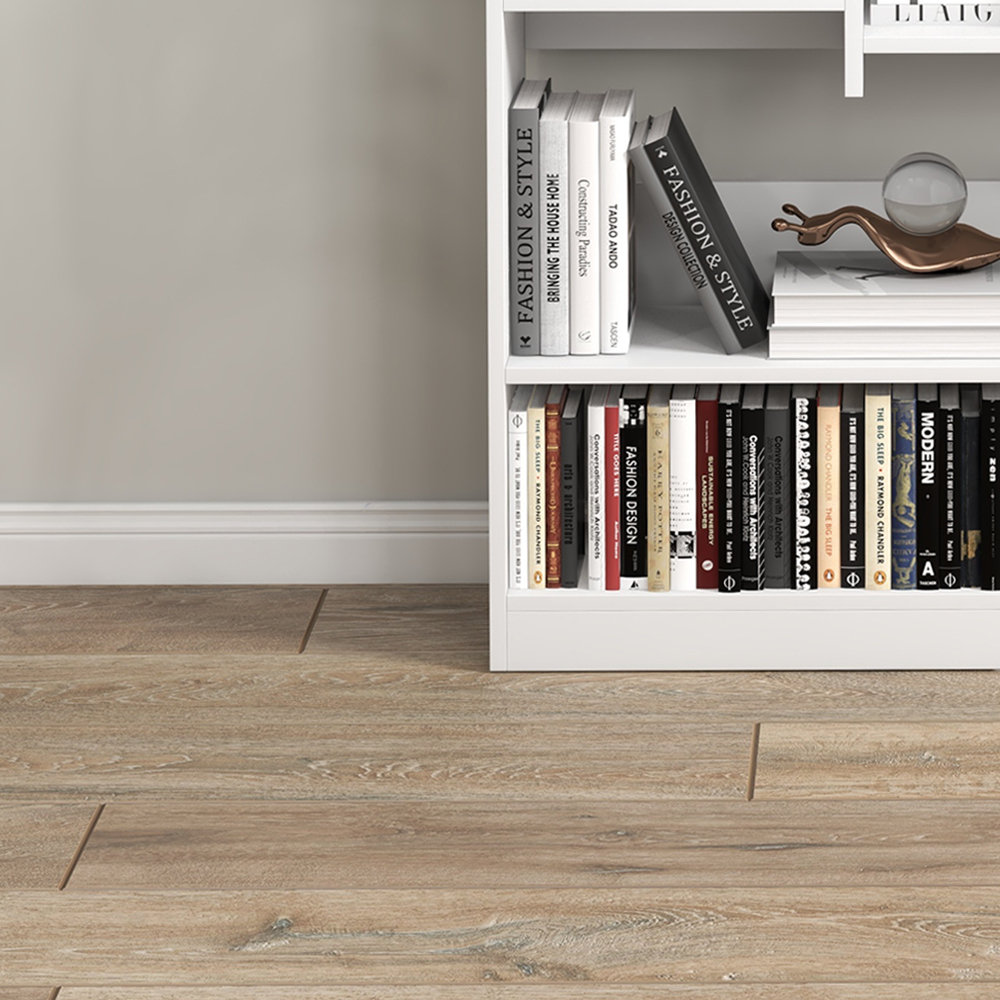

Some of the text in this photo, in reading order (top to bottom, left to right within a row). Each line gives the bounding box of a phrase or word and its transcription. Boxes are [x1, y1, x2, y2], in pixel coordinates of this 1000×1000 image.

[517, 128, 533, 323] FASHION & STYLE
[547, 174, 560, 303] BRINGING THE HOUSE HOME
[575, 179, 590, 277] Constructing Paradies
[608, 204, 618, 269] TADAO ANDO
[661, 210, 708, 291] DESIGN COLLECTION
[663, 165, 754, 331] FASHION & STYLE
[877, 407, 885, 465] THE BIG SLEEP
[921, 412, 935, 484] MODERN
[989, 457, 997, 482] zen
[625, 446, 638, 545] FASHION DESIGN
[749, 435, 758, 560] Conversations with Architects
[774, 436, 783, 559] Conversations with Architects
[877, 476, 885, 564] RAYMOND CHANDLER
[922, 561, 935, 577] A
